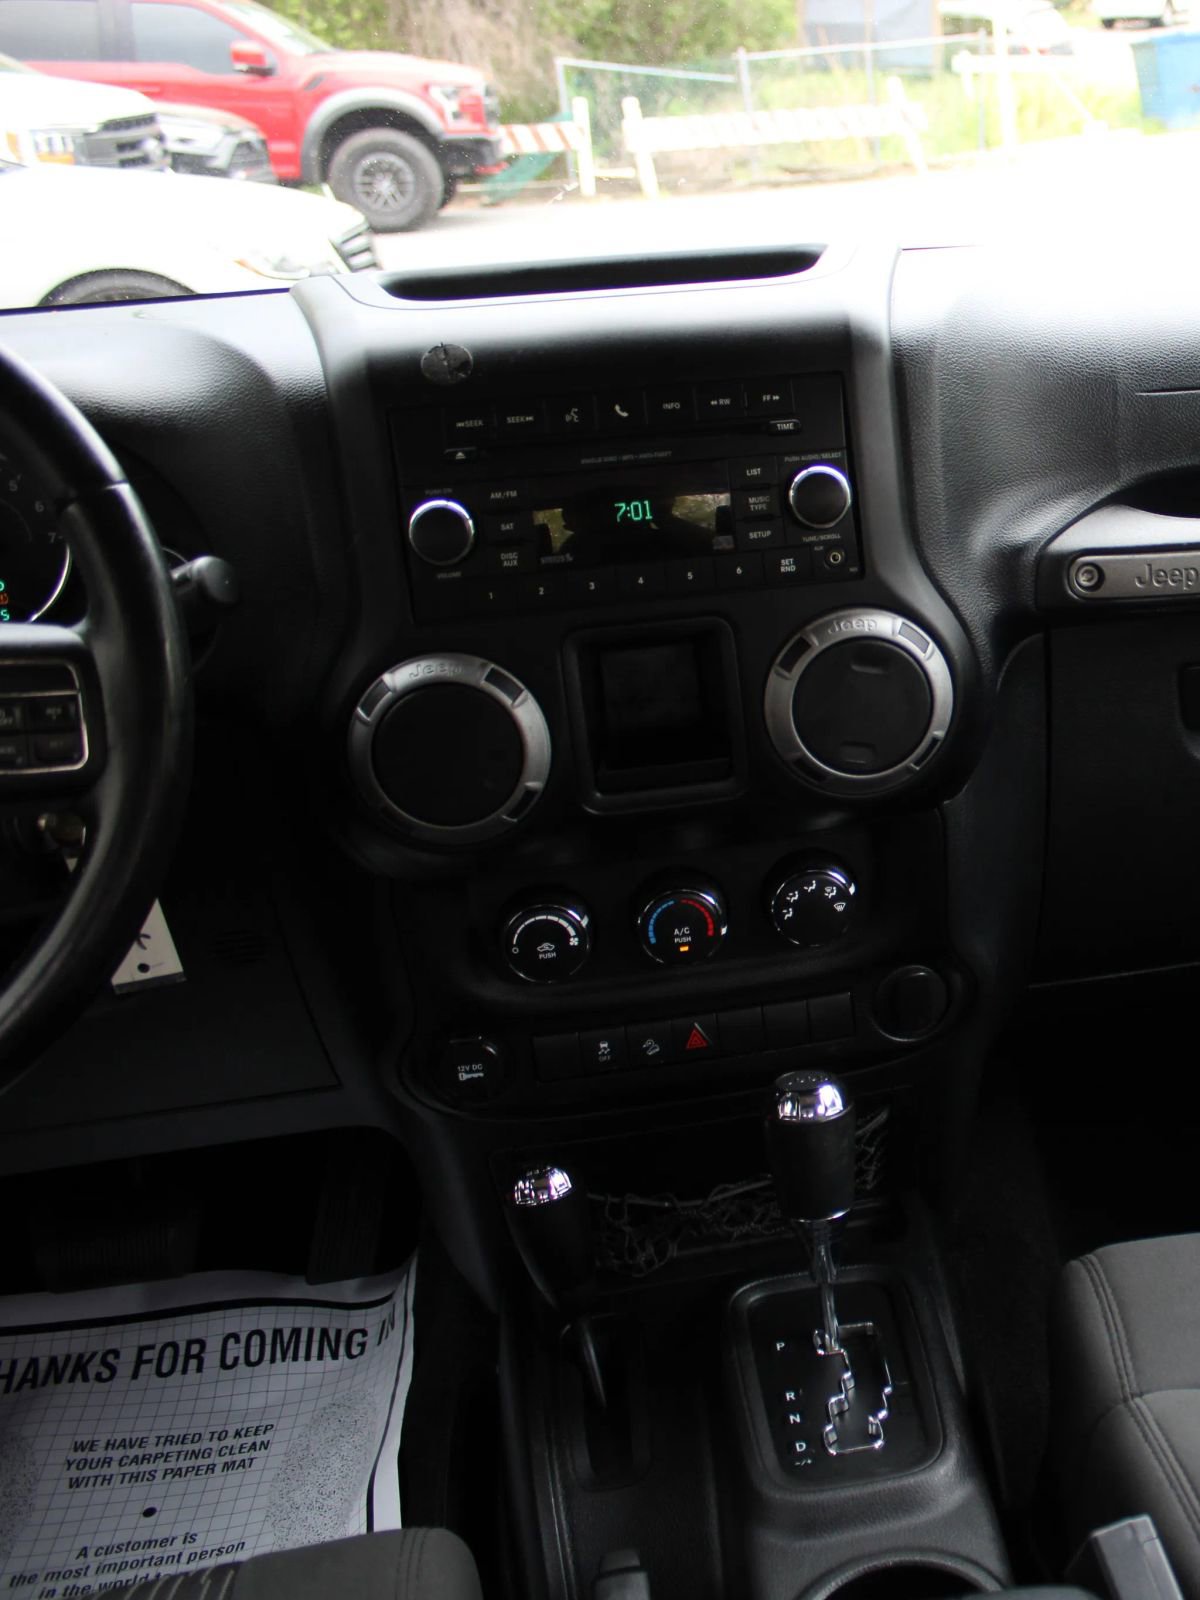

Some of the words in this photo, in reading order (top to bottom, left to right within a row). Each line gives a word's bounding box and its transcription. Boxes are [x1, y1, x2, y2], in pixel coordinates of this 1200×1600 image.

[662, 402, 681, 410] INFO
[506, 415, 526, 424] SEEK
[777, 422, 795, 431] TIME
[746, 468, 761, 476] LIST
[748, 495, 770, 504] MUSIC
[614, 500, 653, 522] 7:01
[749, 503, 767, 511] TYPE
[501, 522, 514, 531] SAT
[749, 530, 771, 539] SETUP
[500, 552, 518, 560] DISC
[503, 559, 518, 567] AUX
[780, 558, 794, 566] SET
[736, 566, 743, 575] 6
[780, 565, 796, 573] RND
[637, 576, 644, 584] 4
[687, 571, 693, 580] 5
[1135, 563, 1199, 590] Jeep
[588, 581, 595, 590] 3
[538, 586, 545, 595] 2
[674, 927, 690, 936] A/C
[674, 935, 692, 943] PUSH
[538, 951, 556, 960] PUSH
[457, 1064, 470, 1073] 12V
[471, 1063, 483, 1072] DC
[0, 1349, 120, 1394] HANKS
[132, 1338, 206, 1380] FOR
[219, 1327, 368, 1370] COMING
[377, 1303, 396, 1346] IN
[775, 1341, 785, 1351] P
[785, 1392, 796, 1402] R
[789, 1413, 801, 1424] N
[73, 1439, 101, 1452] WE
[104, 1436, 149, 1450] HAVE
[155, 1433, 202, 1447] TRIED
[209, 1430, 228, 1442] TO
[233, 1424, 274, 1439] KEEP
[795, 1442, 807, 1452] D
[66, 1457, 113, 1471] YOUR
[118, 1448, 213, 1467] CARPETING
[218, 1440, 270, 1457] CLEAN
[68, 1474, 114, 1489] WITH
[119, 1470, 157, 1485] THIS
[162, 1463, 216, 1480] PAPER
[221, 1457, 257, 1473] MAT
[76, 1546, 88, 1560] A
[94, 1536, 177, 1558] customer
[182, 1532, 198, 1545] is
[9, 1574, 39, 1588] the
[43, 1564, 91, 1583] most
[95, 1552, 183, 1576] important
[186, 1541, 245, 1565] person
[38, 1586, 56, 1600] in
[62, 1581, 92, 1599] the
